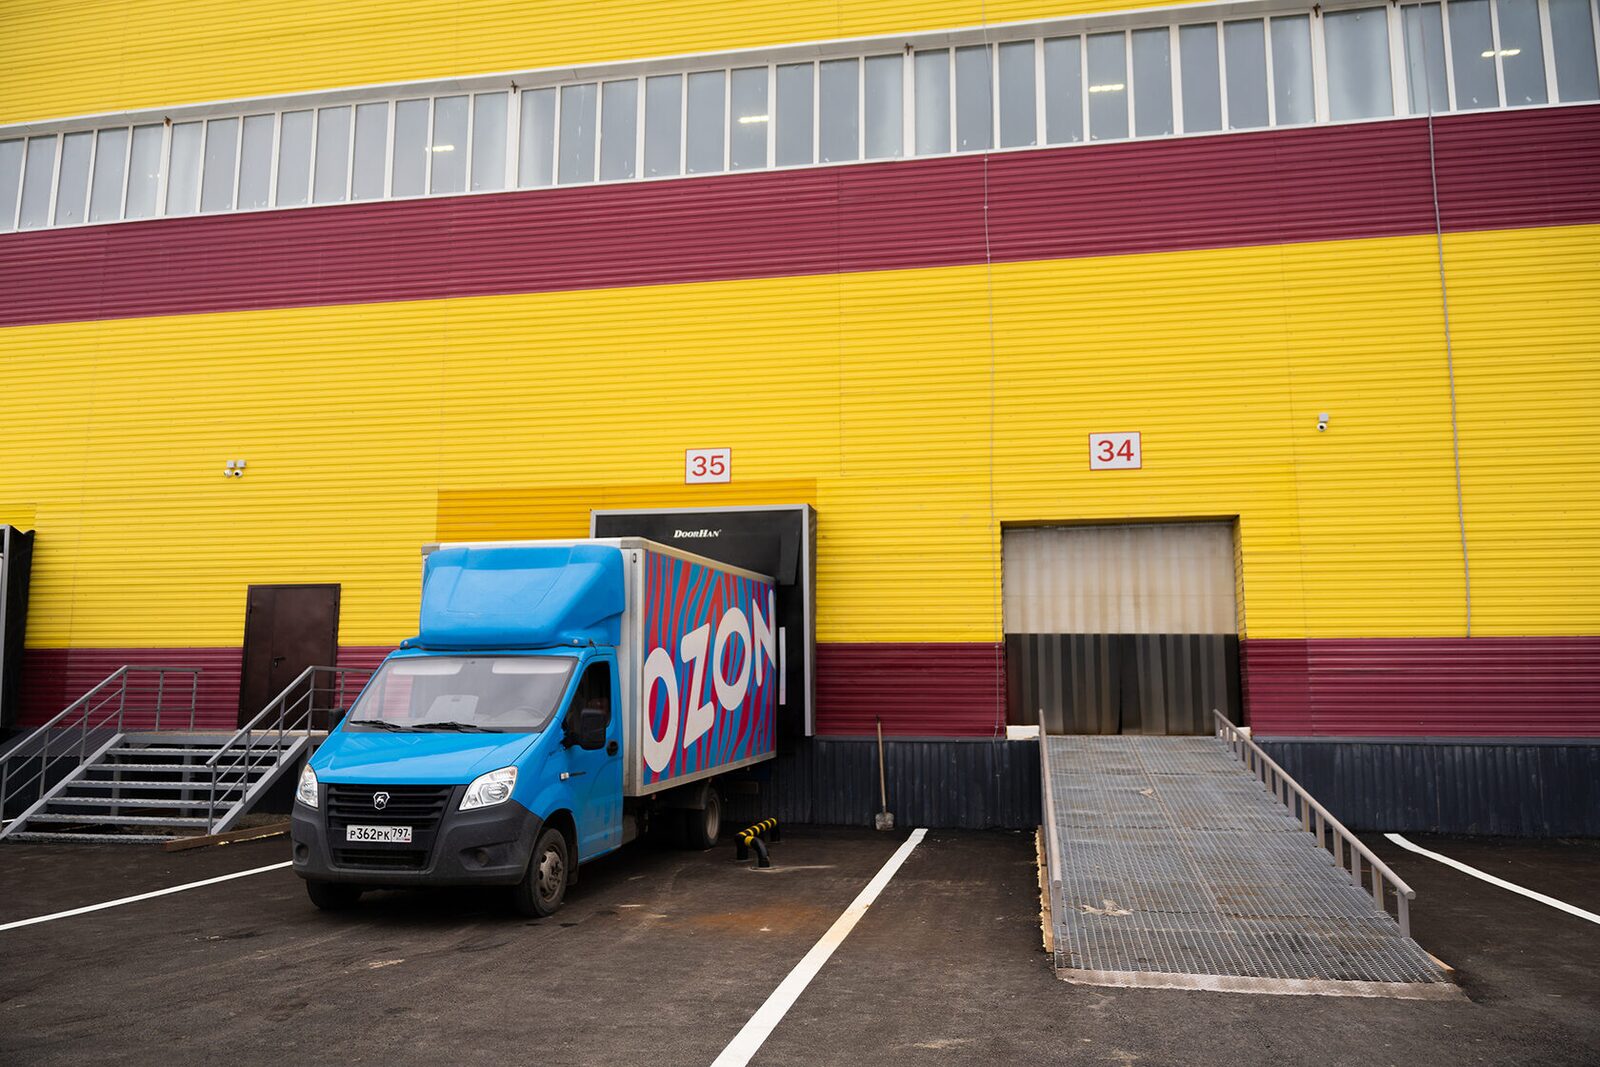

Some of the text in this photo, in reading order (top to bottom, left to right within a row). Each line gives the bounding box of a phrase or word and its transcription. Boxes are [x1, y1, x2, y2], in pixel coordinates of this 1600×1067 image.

[1097, 439, 1135, 462] 34
[691, 455, 725, 477] 35
[643, 589, 776, 773] OZON
